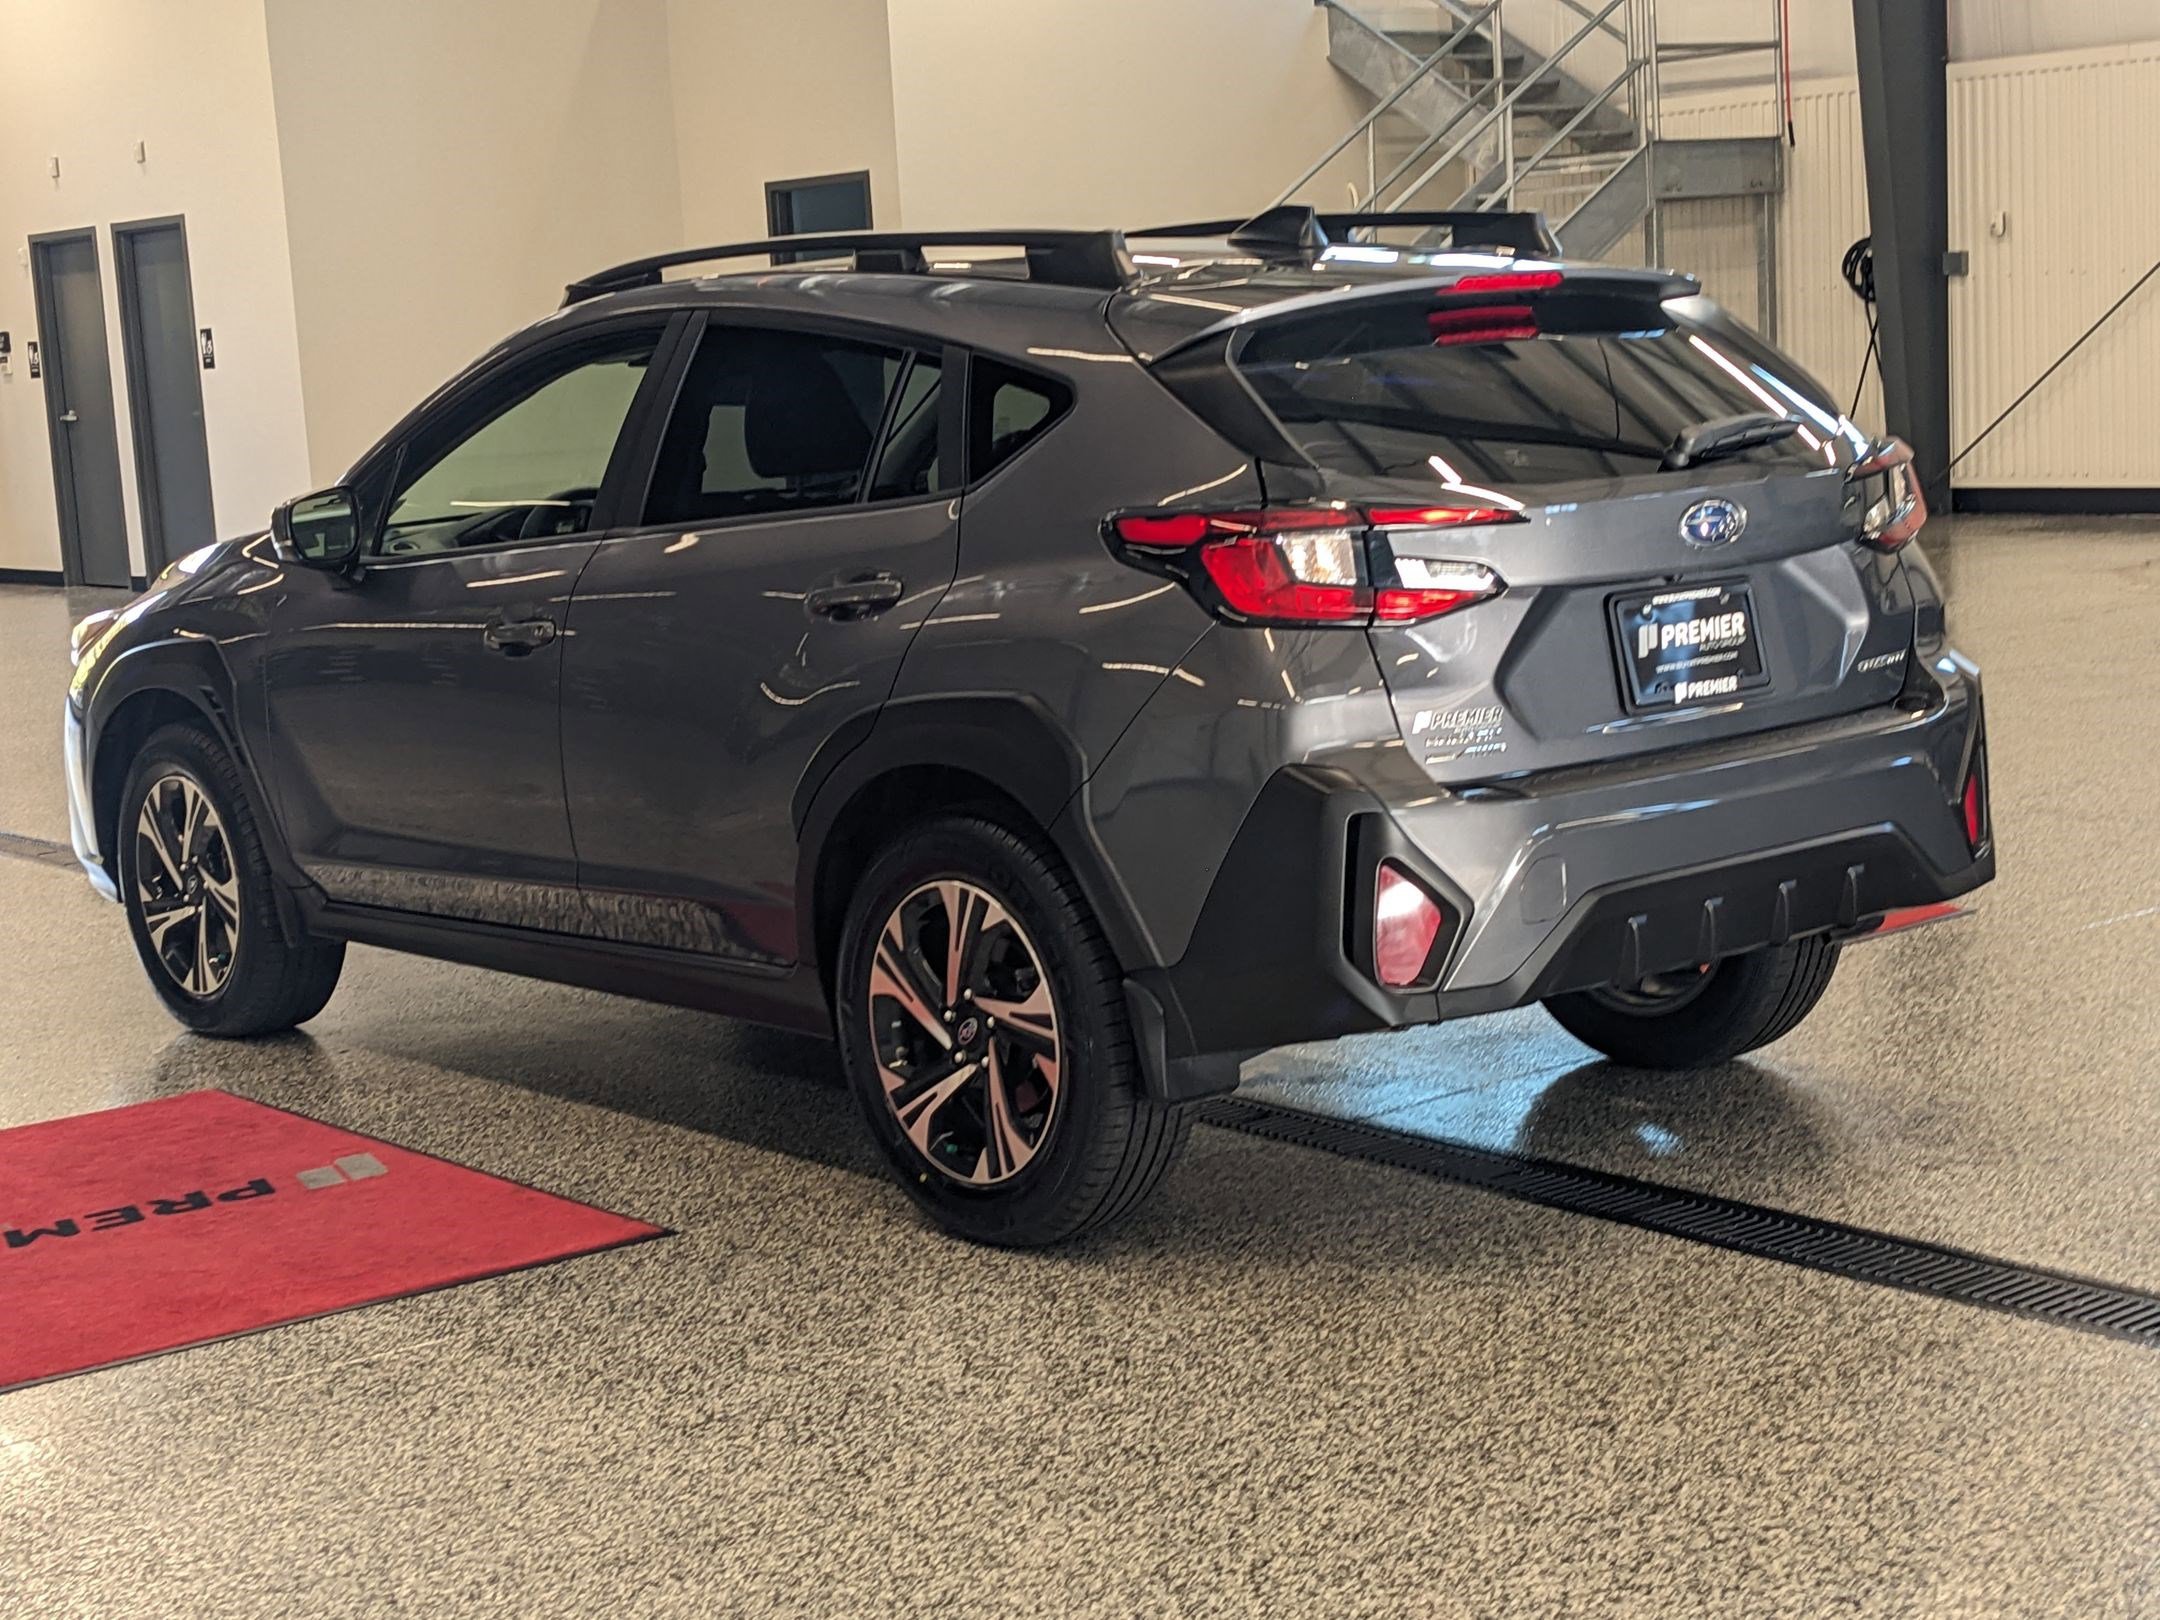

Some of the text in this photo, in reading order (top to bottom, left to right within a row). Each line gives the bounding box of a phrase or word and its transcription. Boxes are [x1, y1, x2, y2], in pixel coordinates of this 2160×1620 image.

[1661, 611, 1746, 650] PREMIER
[1687, 675, 1738, 699] PREMIER
[1429, 705, 1504, 730] PREMIER
[2, 1178, 276, 1248] PREM
